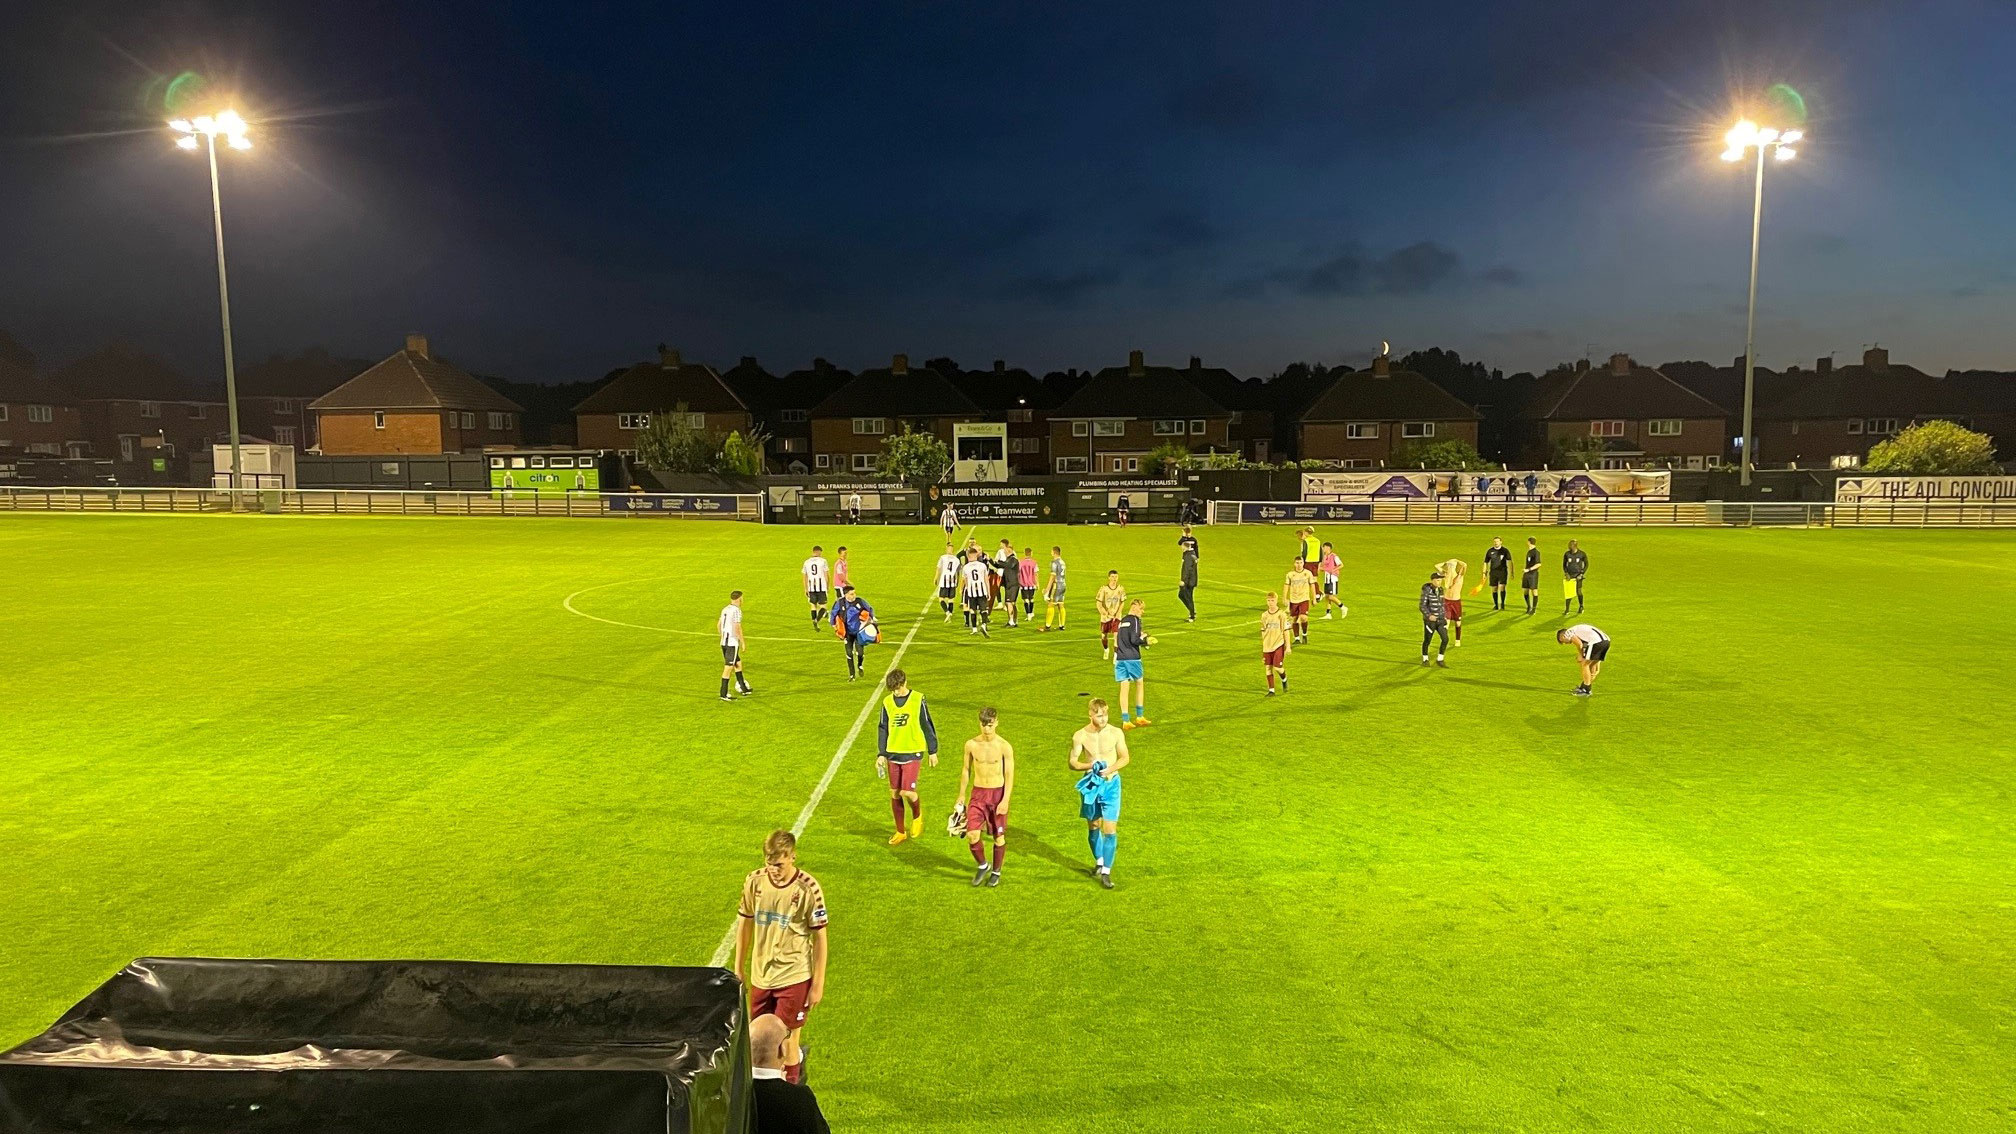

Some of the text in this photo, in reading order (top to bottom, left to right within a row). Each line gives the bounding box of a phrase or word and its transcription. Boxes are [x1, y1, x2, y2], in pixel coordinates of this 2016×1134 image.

[941, 487, 1045, 497] WELCOME TO SPENNYMOOR TOWN FC
[1881, 481, 1911, 499] THE
[1951, 480, 2016, 499] CONCOU
[993, 506, 1036, 515] Teamwear
[811, 563, 818, 576] 9
[971, 569, 979, 581] 6
